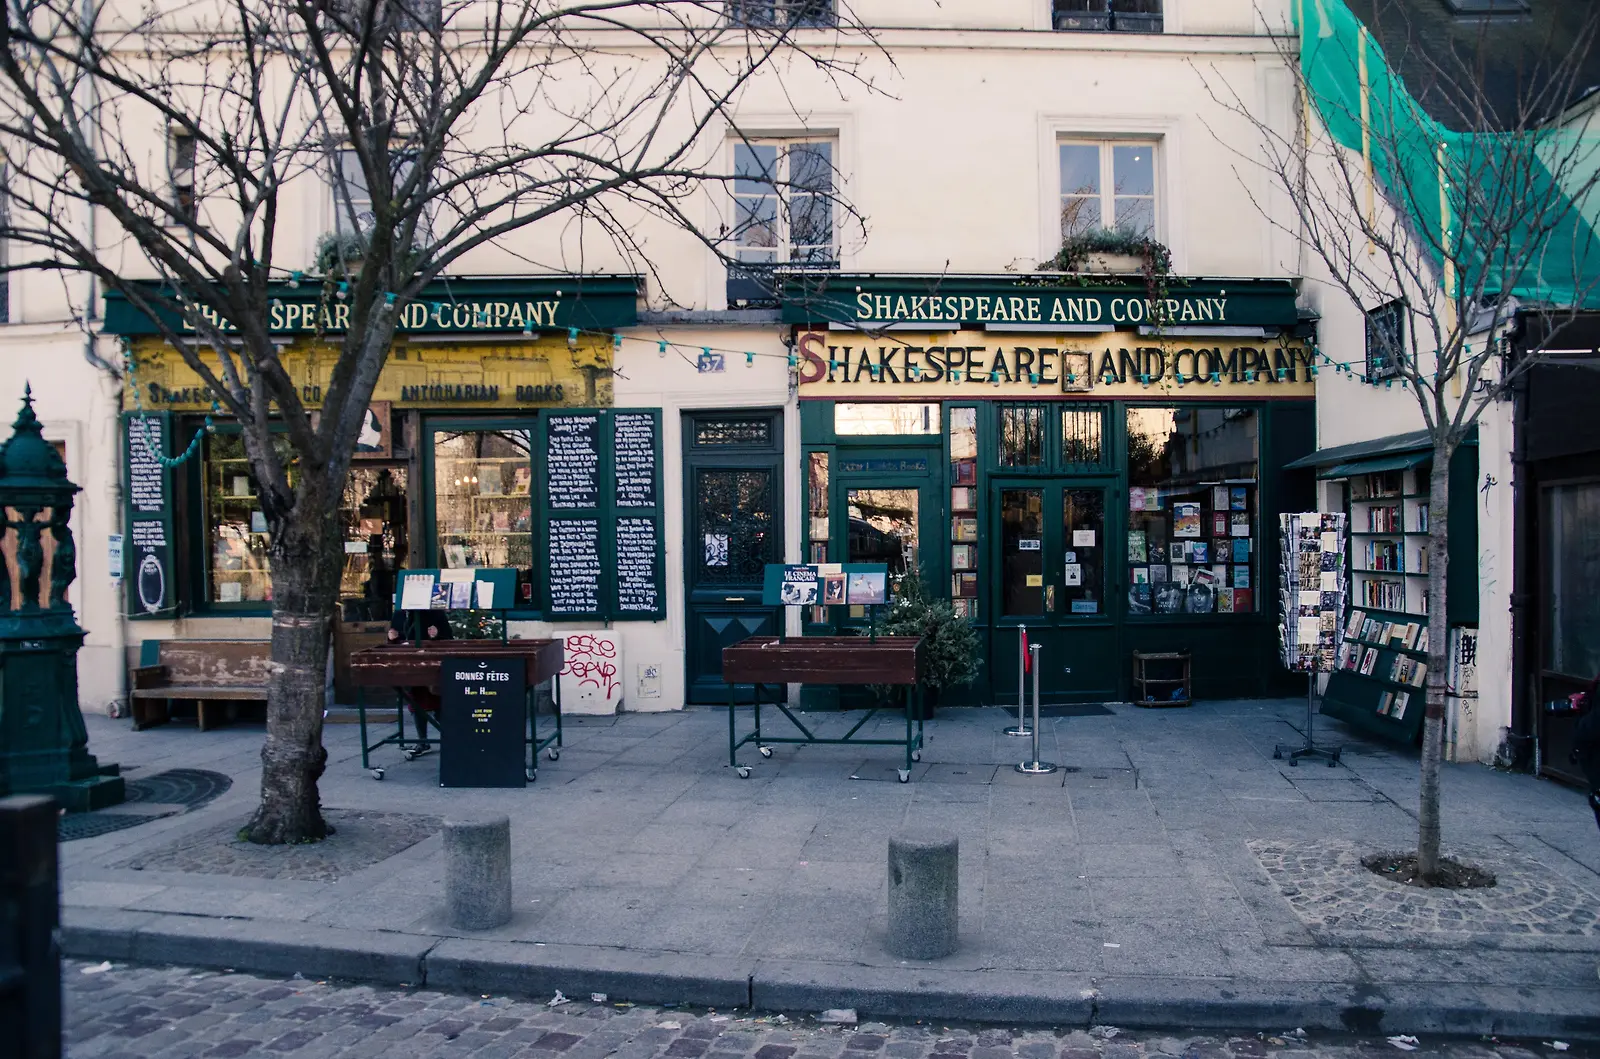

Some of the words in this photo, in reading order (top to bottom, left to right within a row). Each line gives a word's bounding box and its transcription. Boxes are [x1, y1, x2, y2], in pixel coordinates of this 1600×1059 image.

[395, 303, 429, 329] ND
[437, 301, 560, 329] COMPANY
[856, 292, 1041, 321] SHAKESPEARE
[1050, 298, 1101, 322] AND
[1110, 299, 1227, 322] COMPANY
[800, 332, 1059, 386] SHAKESPEARE
[1097, 347, 1165, 384] AND
[1174, 347, 1315, 384] COMPANY
[400, 384, 499, 401] ANTIQUARIAN
[516, 383, 563, 401] BOOKS
[455, 672, 485, 681] BONNES
[486, 670, 509, 681] FÊTES
